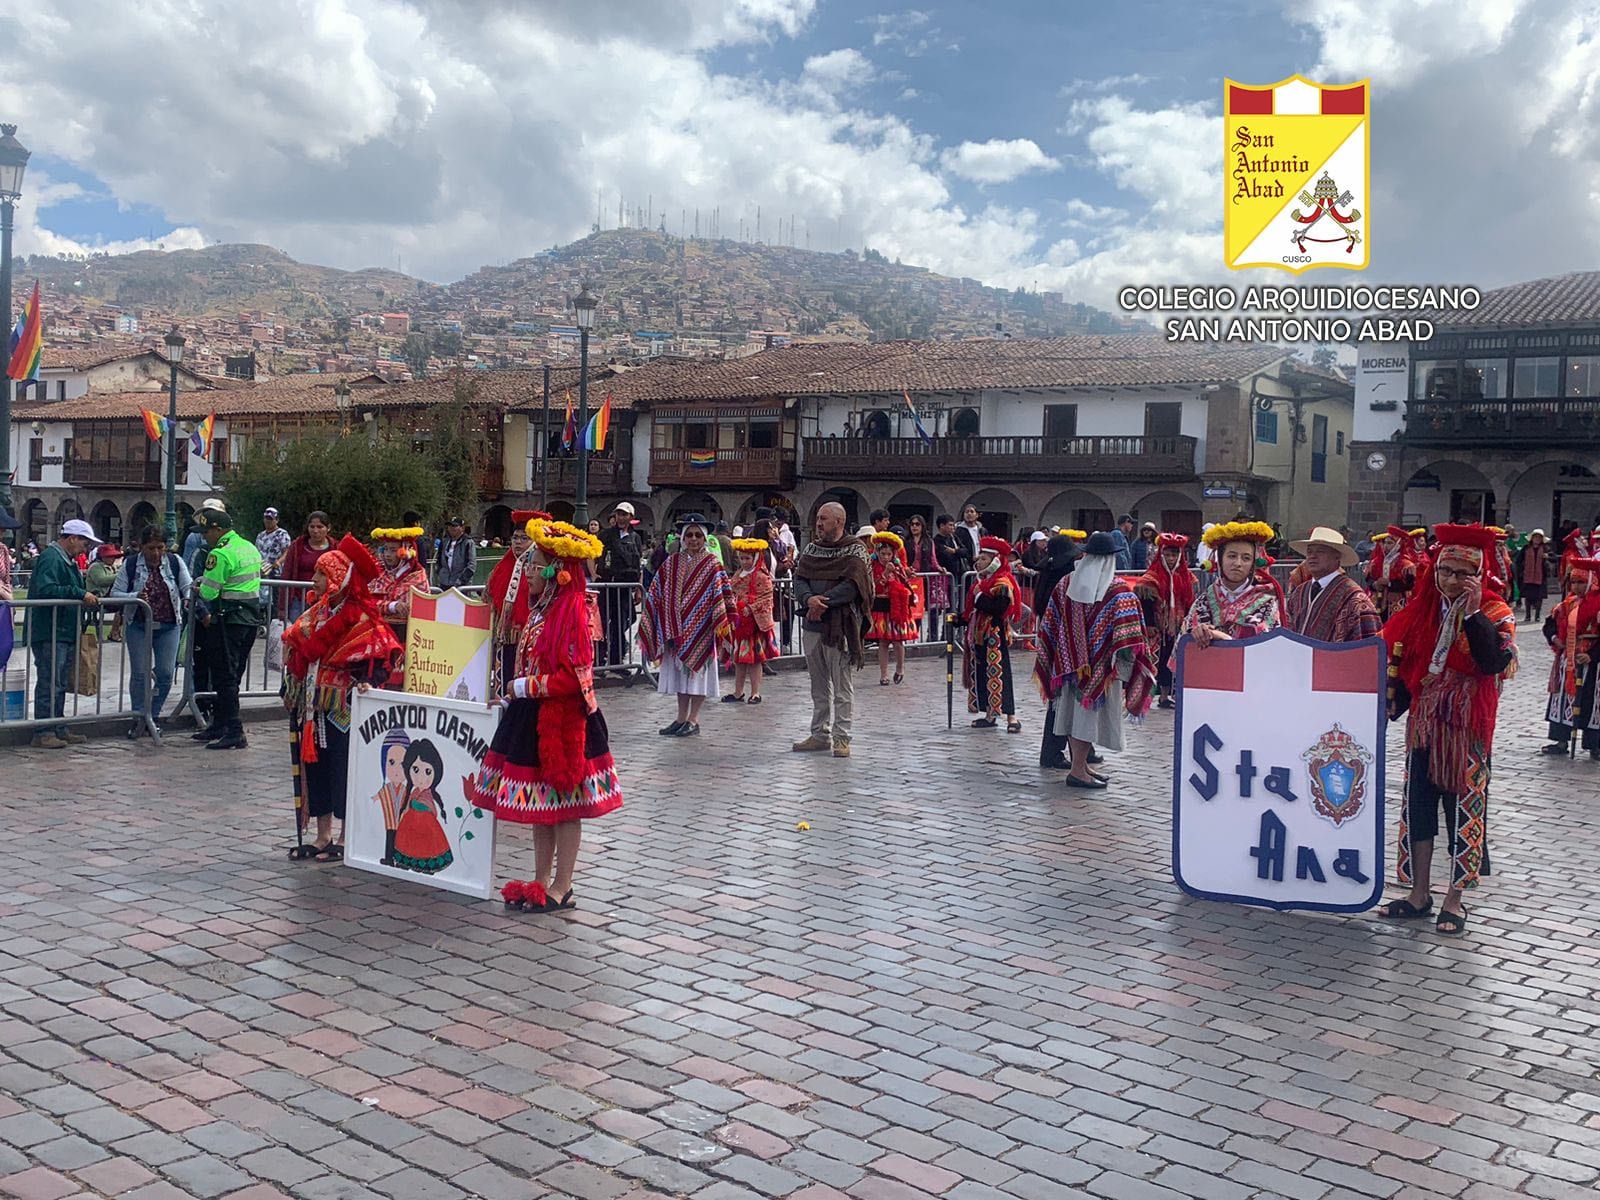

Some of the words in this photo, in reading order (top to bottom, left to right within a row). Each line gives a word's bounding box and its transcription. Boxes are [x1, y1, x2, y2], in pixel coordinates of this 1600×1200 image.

[1361, 357, 1407, 369] MORENA
[409, 628, 435, 651] San
[408, 651, 454, 676] Antonio
[407, 673, 438, 695] Abad
[359, 705, 427, 745] VARAYOQ
[1189, 723, 1298, 801] Sta
[1250, 808, 1370, 884] Ana
